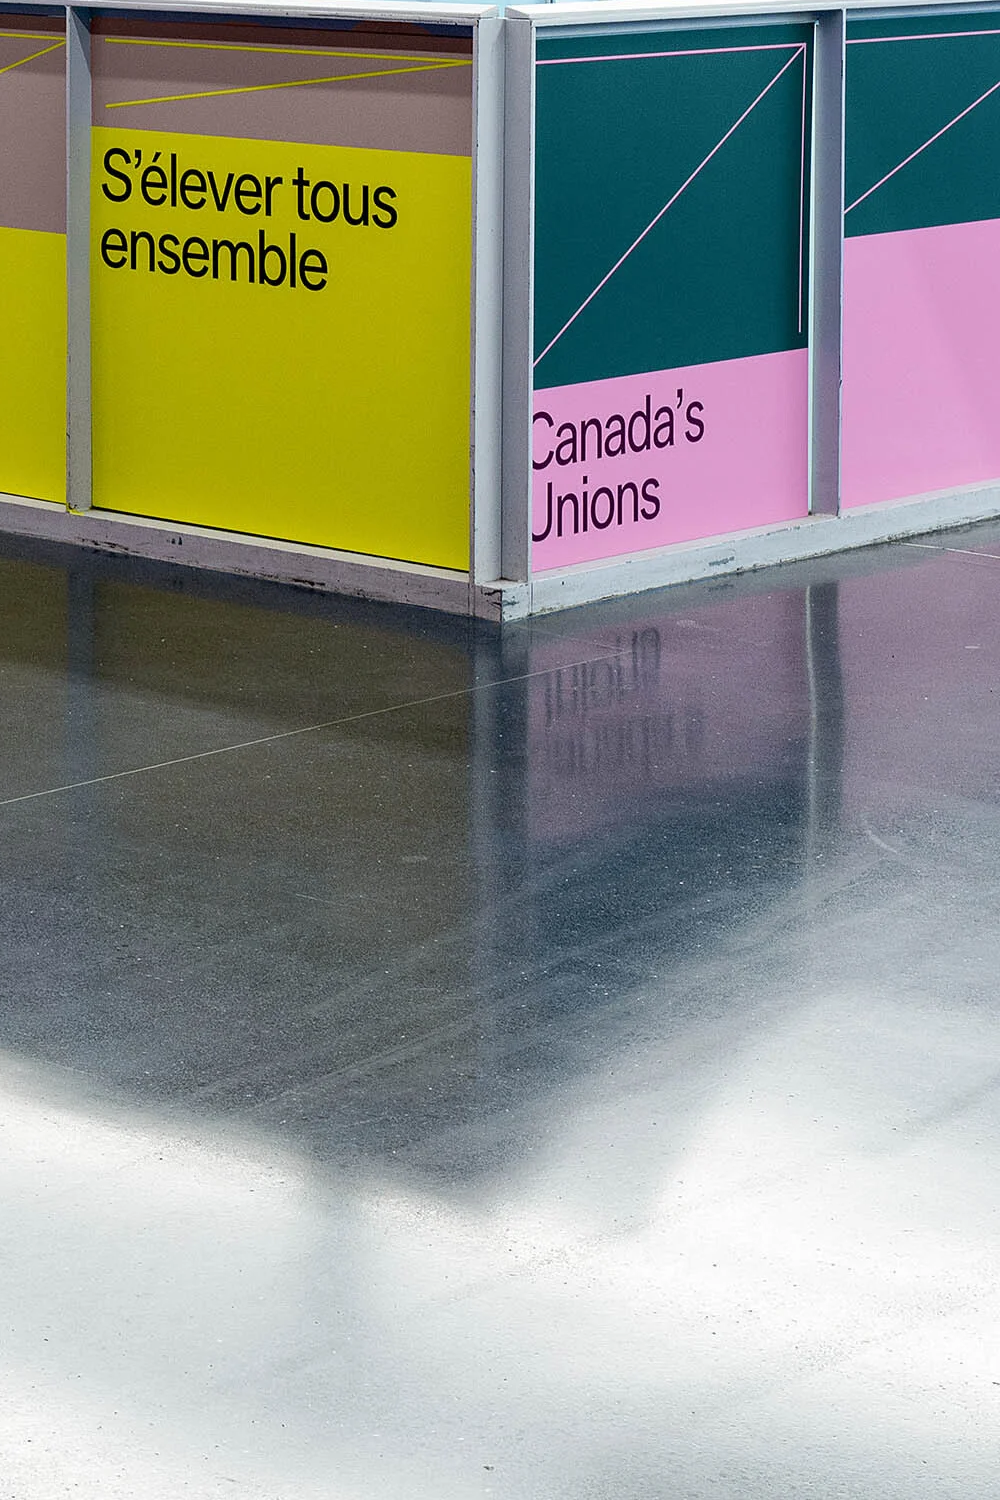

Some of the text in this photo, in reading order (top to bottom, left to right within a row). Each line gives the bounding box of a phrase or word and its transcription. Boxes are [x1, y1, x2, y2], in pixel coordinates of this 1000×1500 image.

[102, 148, 398, 228] S’élever tous
[101, 228, 328, 291] ensemble
